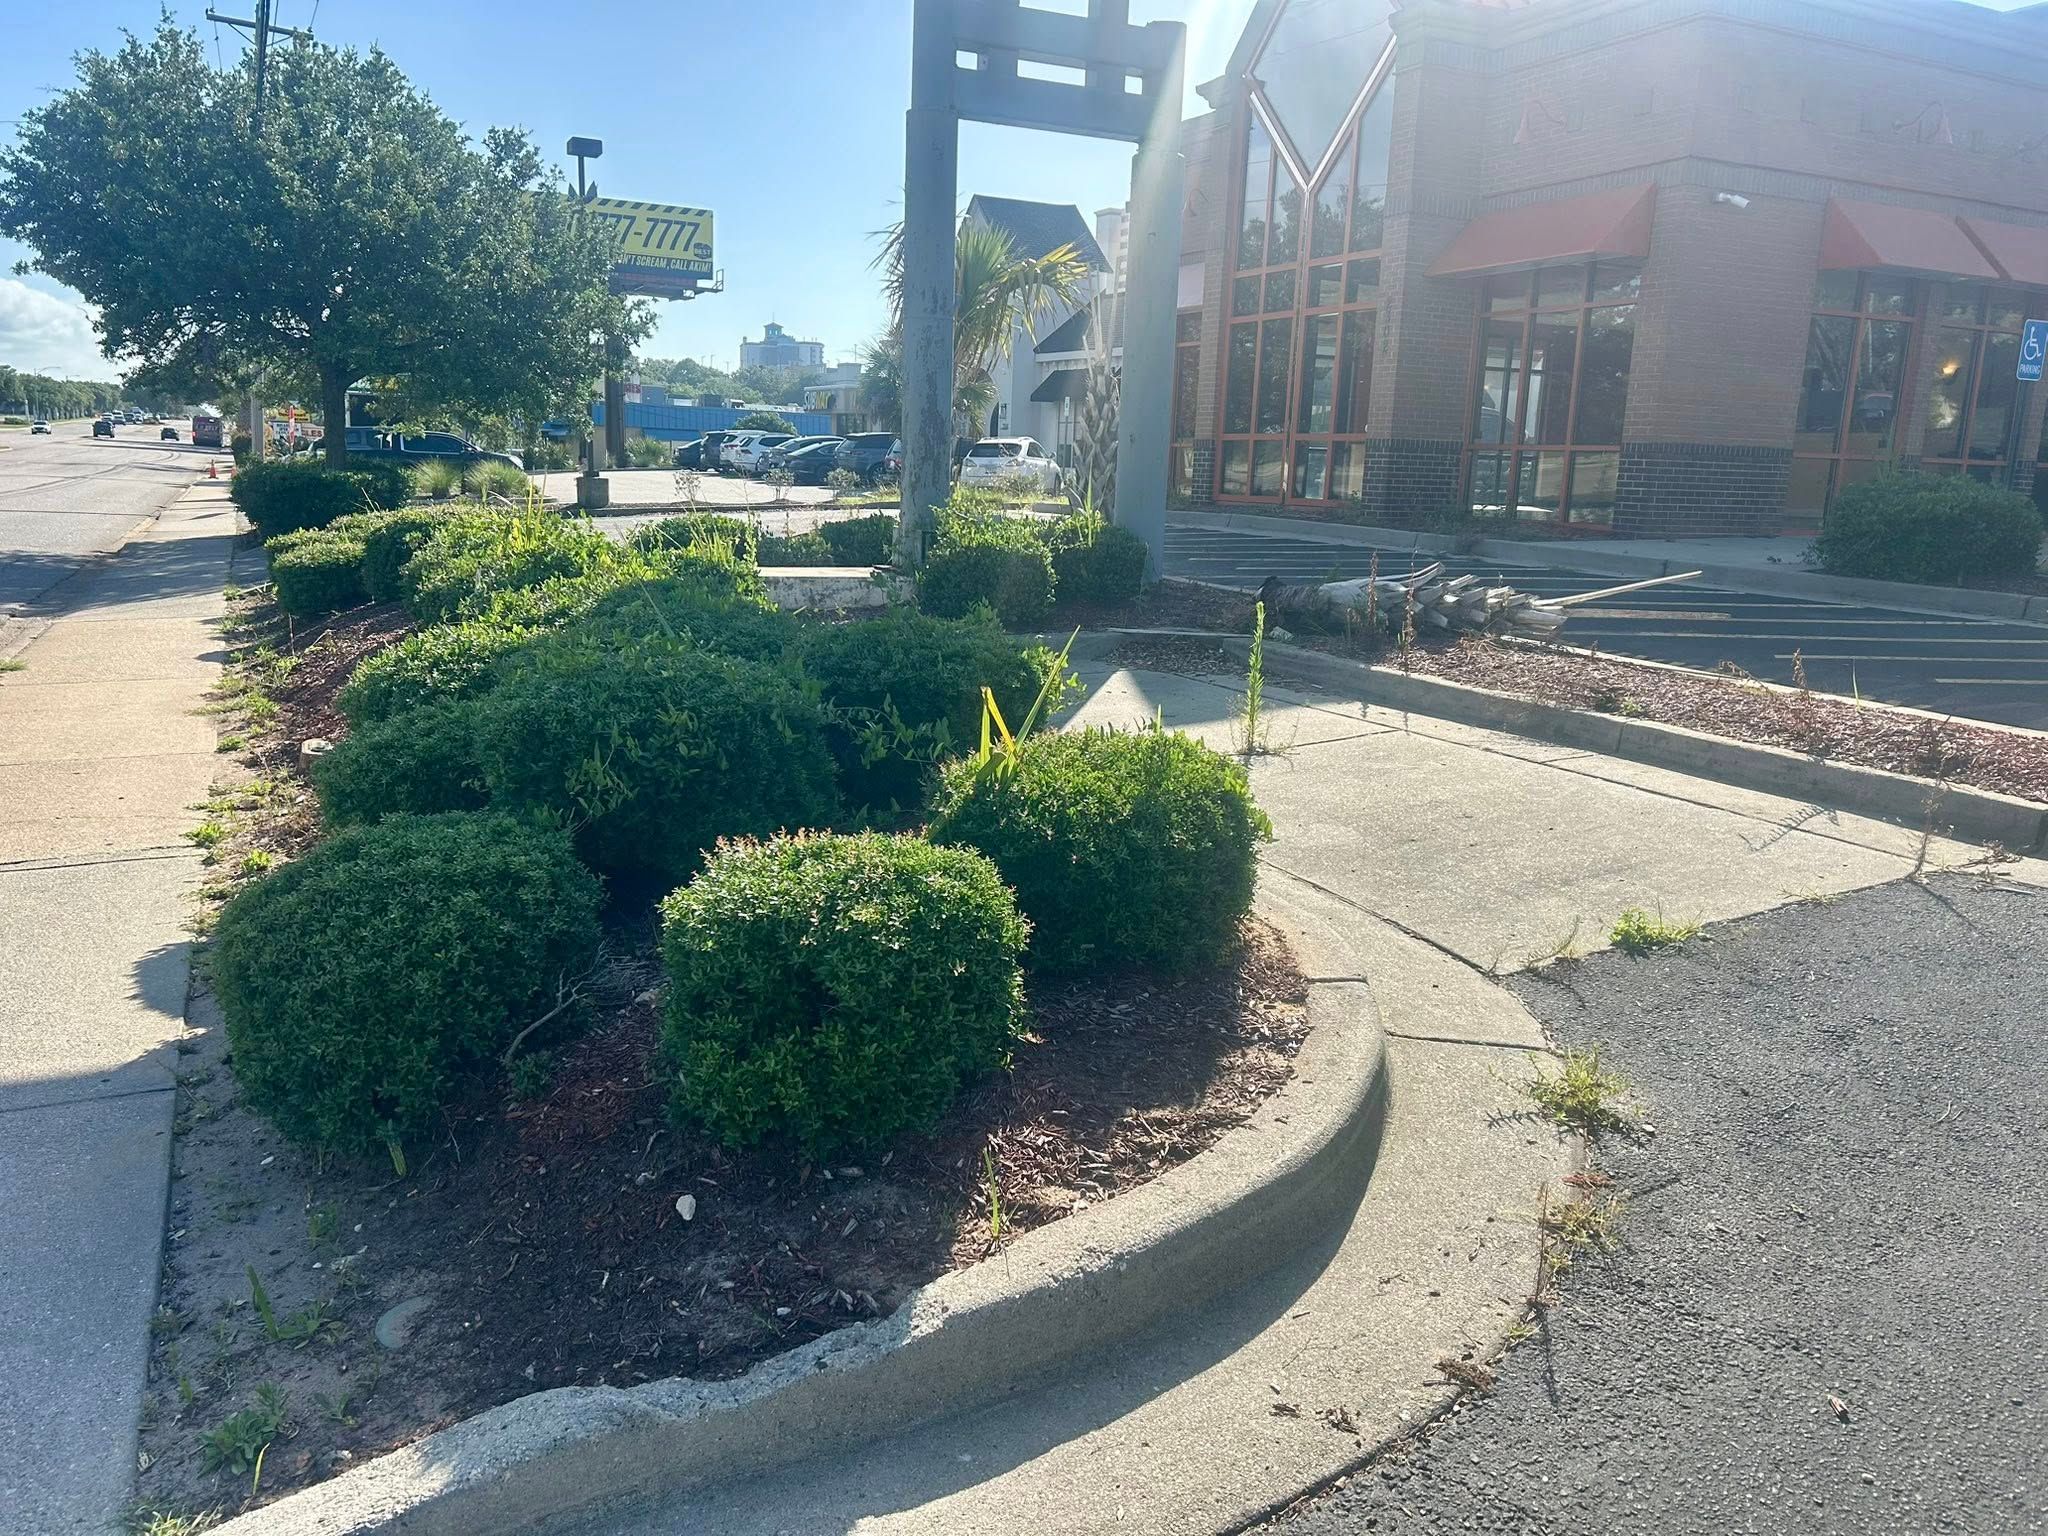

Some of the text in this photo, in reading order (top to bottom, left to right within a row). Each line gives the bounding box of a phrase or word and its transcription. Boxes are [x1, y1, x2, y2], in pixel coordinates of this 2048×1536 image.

[670, 259, 688, 271] CALL
[688, 261, 711, 273] AKIM!
[2018, 363, 2041, 375] PARKING
